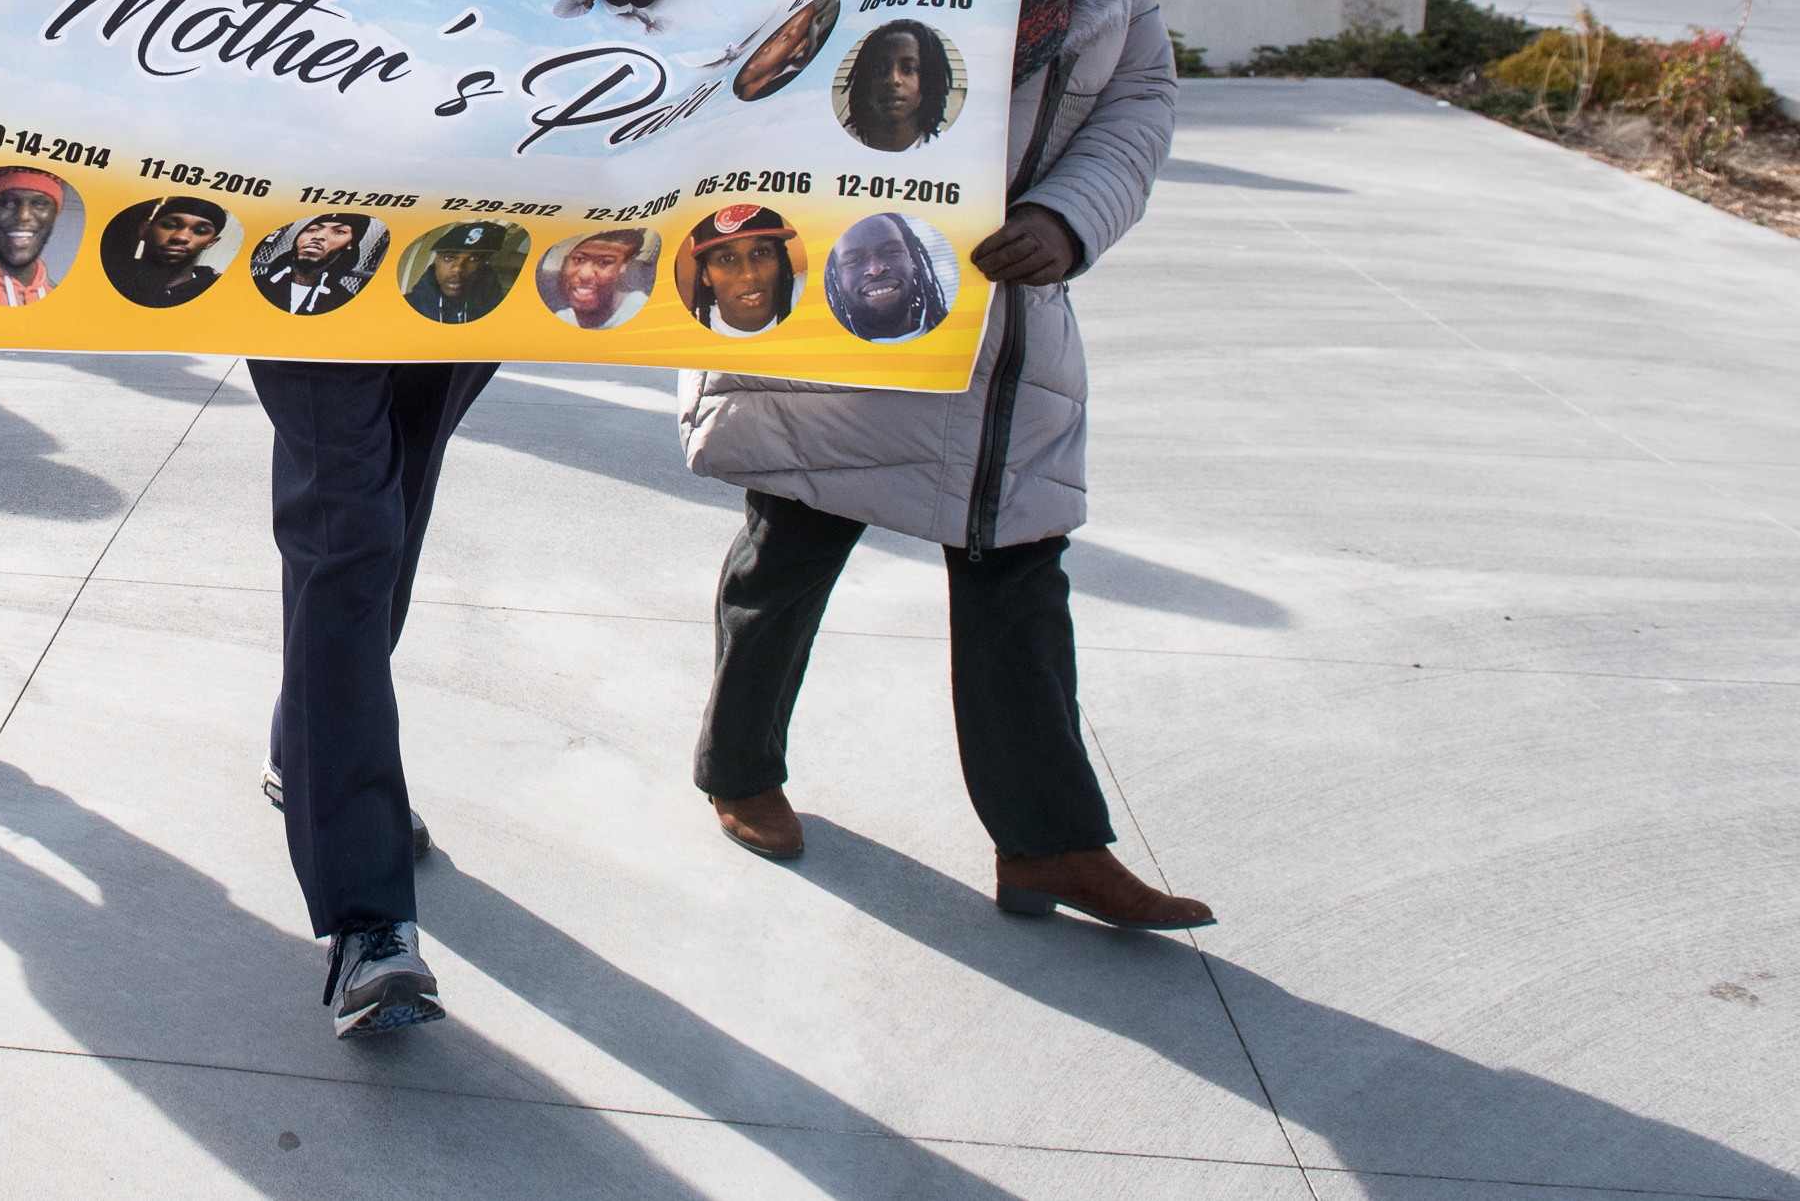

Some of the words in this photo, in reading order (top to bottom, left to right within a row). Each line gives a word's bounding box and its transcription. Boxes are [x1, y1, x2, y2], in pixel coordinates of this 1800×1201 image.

[139, 157, 272, 198] 11-03-2016
[694, 171, 812, 197] 05-26-2016
[836, 174, 961, 205] 12-01-2016
[298, 185, 421, 209] 11-21-2015
[441, 198, 562, 217] 12-29-2012
[583, 189, 680, 222] 12-12-2016
